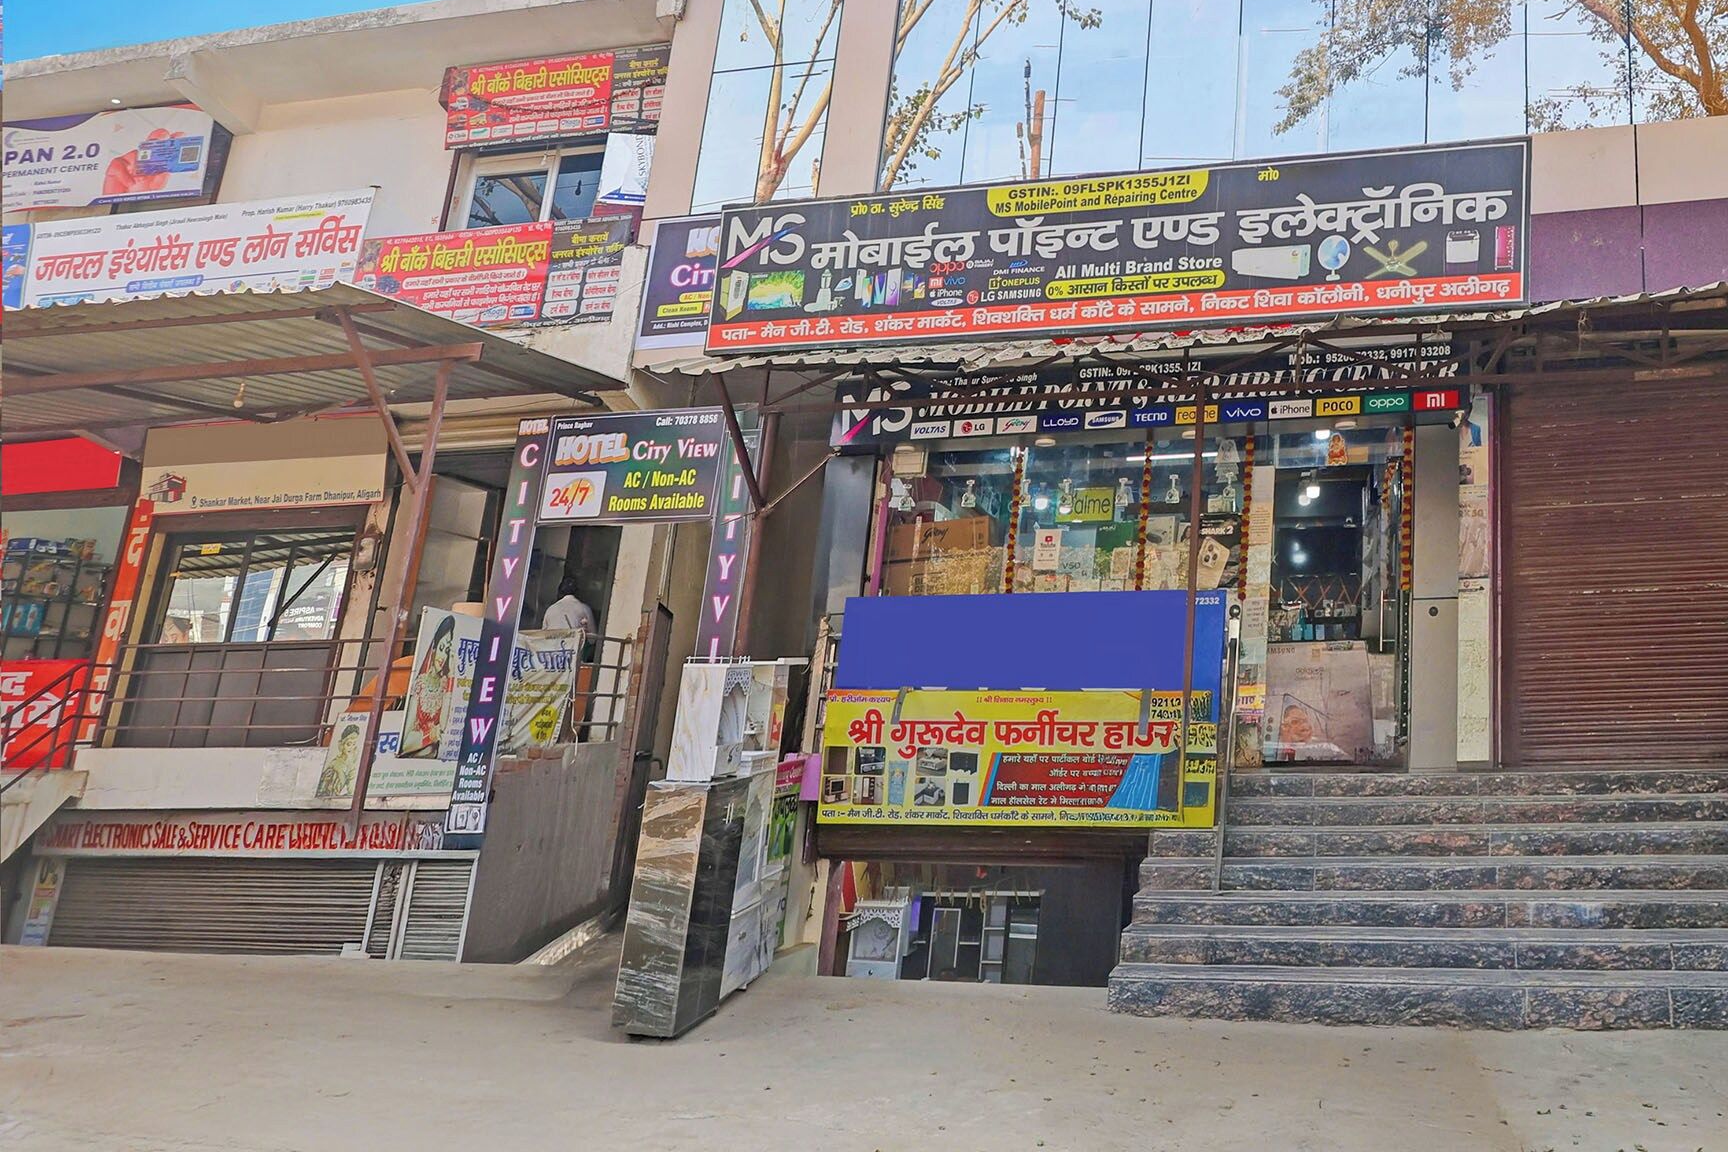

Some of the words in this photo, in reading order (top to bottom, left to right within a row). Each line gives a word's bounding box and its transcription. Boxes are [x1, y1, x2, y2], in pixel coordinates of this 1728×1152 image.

[470, 74, 486, 96] श्री
[512, 66, 548, 91] बिहारी
[4, 146, 54, 166] PAN
[62, 143, 100, 160] 2.0
[60, 163, 99, 173] CENTRE
[922, 195, 945, 210] सिंह
[995, 201, 1011, 214] MS
[1080, 196, 1099, 209] and
[1104, 191, 1158, 206] Repairing
[1160, 188, 1198, 202] Centre
[810, 221, 983, 269] मोबाईल
[988, 215, 1122, 261] पॉइन्ट
[1131, 210, 1225, 249] एण्ड
[1236, 182, 1513, 245] इलेक्ट्रॉनिक
[726, 213, 806, 265] MS
[35, 250, 108, 281] जनरल
[194, 236, 242, 269] एण्ड
[242, 224, 293, 264] लोन
[295, 214, 363, 258] सर्विस
[1010, 266, 1045, 274] FINANCE
[1055, 264, 1077, 279] All
[1080, 262, 1122, 278] Multi
[1125, 257, 1174, 274] Brand
[1178, 255, 1223, 270] Store
[1001, 276, 1041, 287] ONEPLUS
[1048, 284, 1064, 297] 0%
[1067, 280, 1108, 296] आसान
[1154, 277, 1170, 290] पर
[1172, 273, 1219, 288] उपलब्ध
[937, 288, 963, 298] iPhone
[980, 290, 995, 302] LG
[997, 288, 1042, 301] SAMSUNG
[761, 322, 786, 338] मैन
[875, 316, 915, 332] शंकर
[972, 309, 1045, 327] शिवशक्ति
[1117, 299, 1136, 316] के
[1200, 292, 1251, 311] निकट
[1254, 289, 1293, 308] शिवा
[1376, 282, 1436, 306] धनीपुर
[1440, 279, 1512, 298] अलीगढ़
[1322, 399, 1354, 413] POCO
[1369, 396, 1404, 409] oppo
[1225, 406, 1262, 418] vivo
[1279, 404, 1311, 415] iPhone
[656, 416, 674, 427] Call:
[674, 415, 698, 425] 70378
[1042, 416, 1079, 427] LLOYD
[1091, 415, 1122, 424] SAMSUNG
[1134, 411, 1168, 422] TECNO
[518, 418, 549, 435] HOTEL
[913, 424, 946, 435] VOLTAS
[974, 423, 986, 432] LG
[555, 432, 630, 466] HOTEL
[623, 472, 641, 489] AC
[651, 468, 696, 487] Non-AC
[200, 497, 227, 507] Shankar
[254, 495, 271, 504] Near
[283, 493, 304, 503] Durga
[304, 492, 322, 501] Farm
[356, 488, 381, 499] Aligarh
[607, 495, 647, 512] Rooms
[649, 492, 705, 511] Available
[848, 709, 885, 745] श्री
[890, 710, 988, 759] गुरूदेव
[994, 708, 1094, 748] फर्नीचर
[466, 752, 478, 764] AC
[1002, 753, 1022, 764] हमारे
[1039, 755, 1049, 763] पर
[459, 765, 486, 777] Non-AC
[1070, 769, 1081, 777] पर
[458, 777, 483, 789] Rooms
[996, 782, 1016, 791] दिल्ली
[1019, 783, 1030, 791] का
[1031, 783, 1047, 791] माल
[452, 789, 485, 802] Available
[991, 797, 1007, 805] माल
[1038, 796, 1049, 805] रेट
[821, 810, 837, 818] पता
[904, 808, 925, 819] शंकर
[82, 821, 153, 848] ELECTRONICS
[152, 821, 178, 848] SALE
[186, 821, 242, 849] SERVICE
[243, 821, 290, 849] CARE
